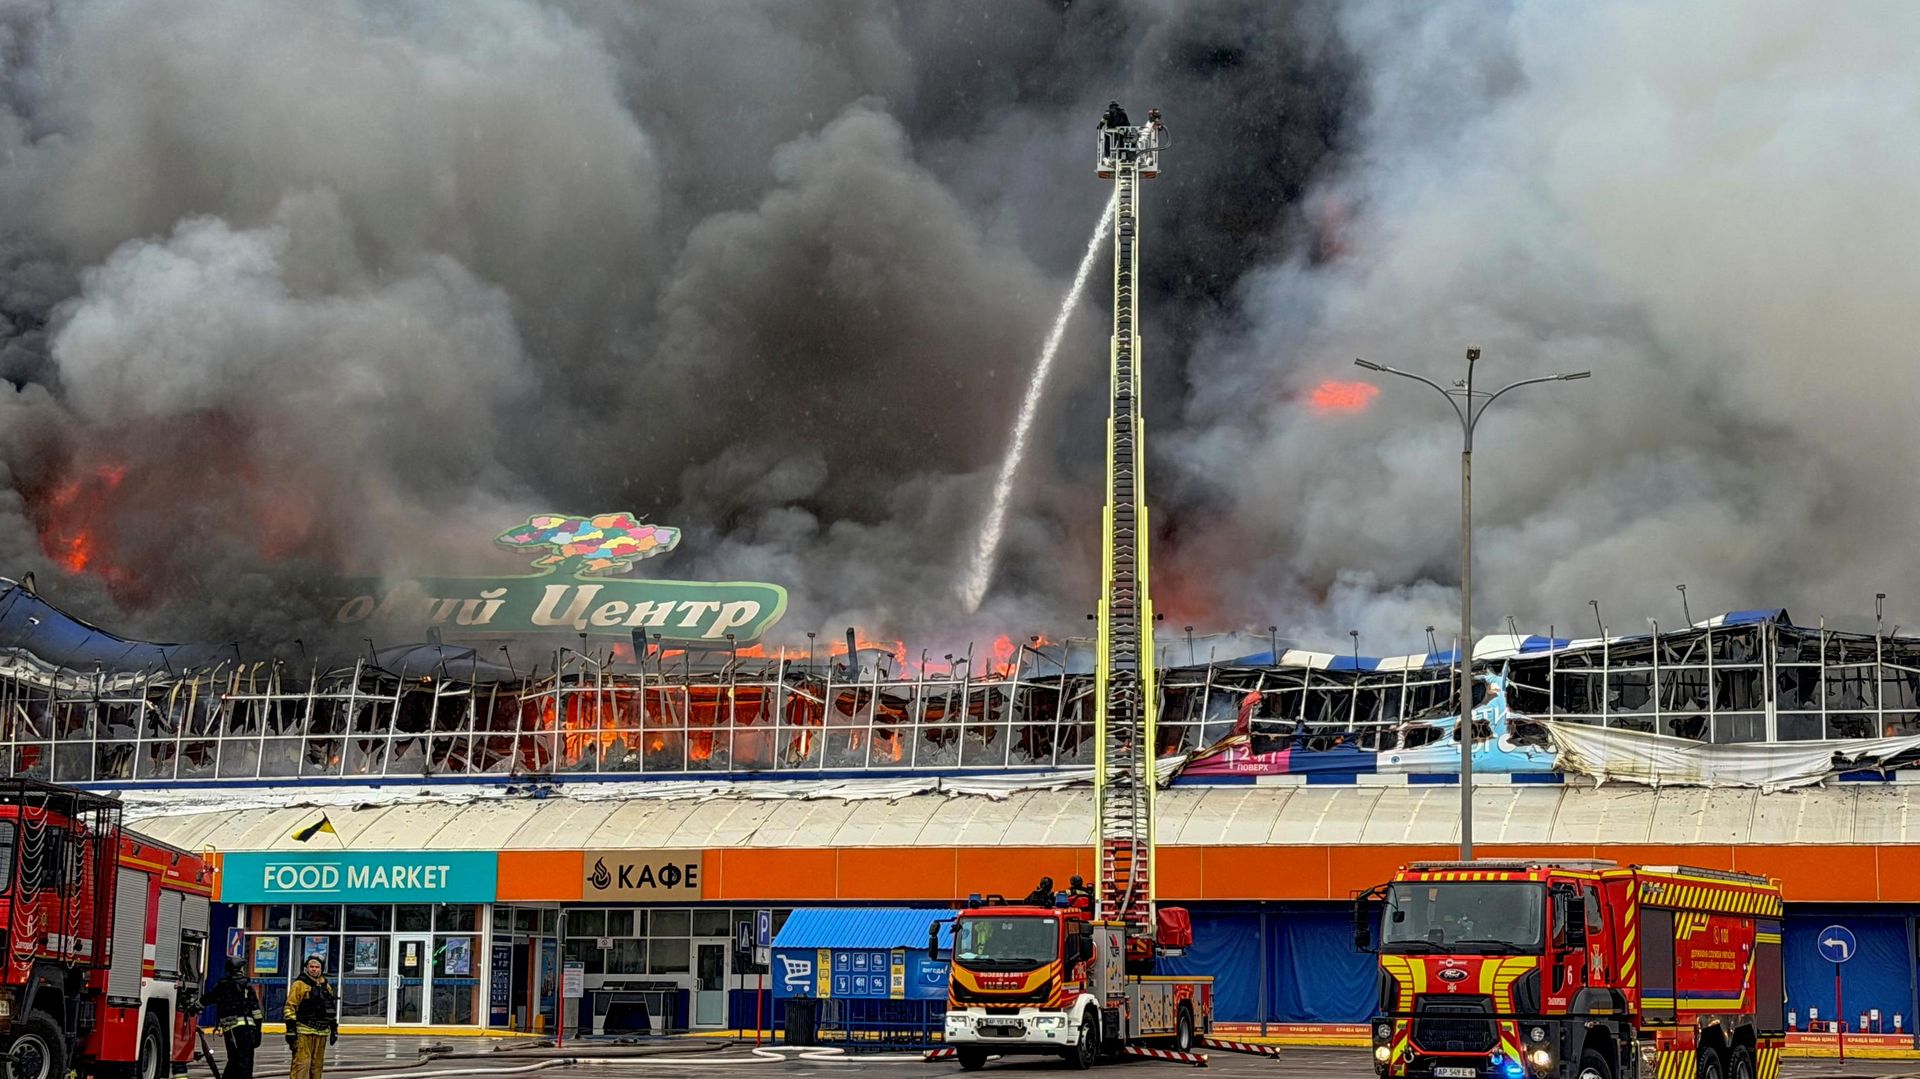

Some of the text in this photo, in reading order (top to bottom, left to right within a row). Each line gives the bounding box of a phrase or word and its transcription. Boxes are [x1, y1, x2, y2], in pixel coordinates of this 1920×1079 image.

[530, 584, 762, 639] Центр
[263, 865, 451, 889] FOOD MARKET
[618, 862, 699, 889] КАФЕ
[761, 915, 768, 942] P
[984, 981, 1018, 990] IVECO
[1444, 969, 1461, 979] Ford
[1567, 965, 1573, 985] 6
